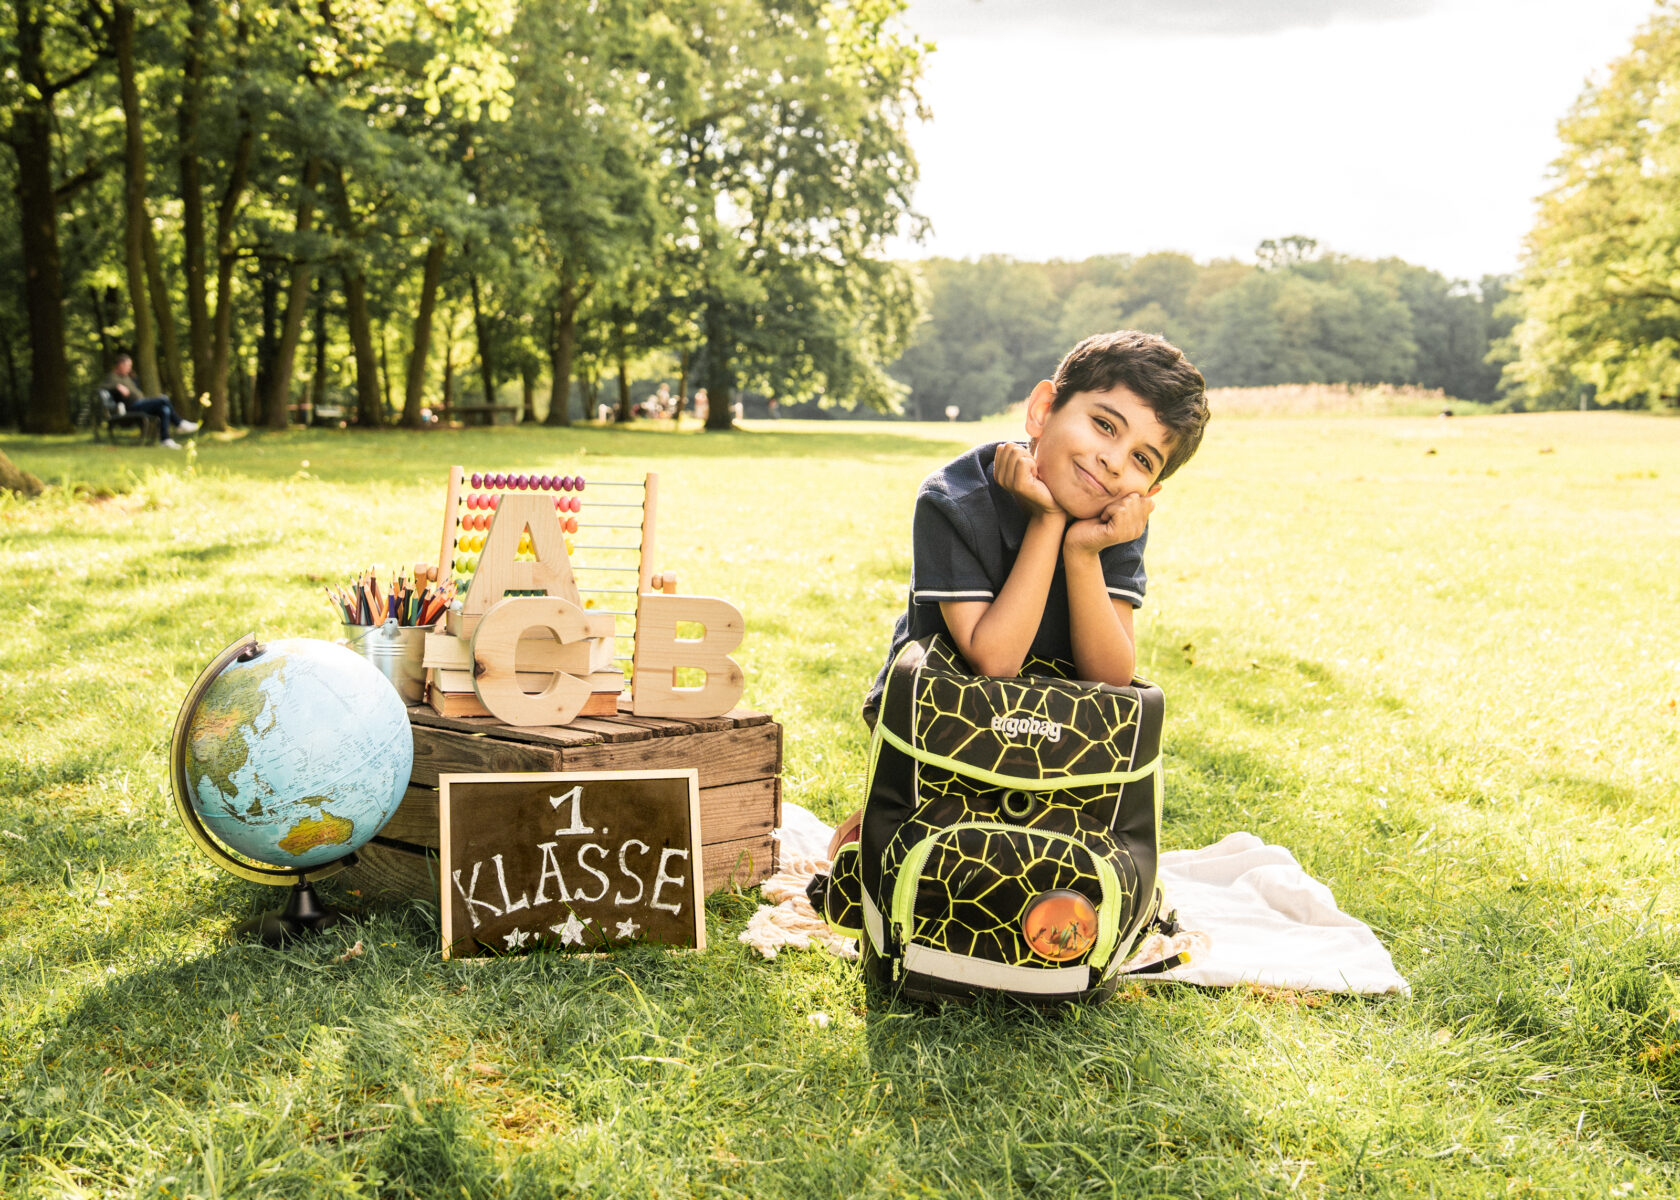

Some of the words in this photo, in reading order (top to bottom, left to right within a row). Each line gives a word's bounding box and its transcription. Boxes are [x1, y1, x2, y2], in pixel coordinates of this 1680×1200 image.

[464, 494, 583, 614] A
[470, 596, 592, 726] C
[633, 593, 745, 718] B
[991, 716, 1062, 742] ergobag
[549, 785, 609, 836] 1.
[452, 839, 689, 929] KLASSE
